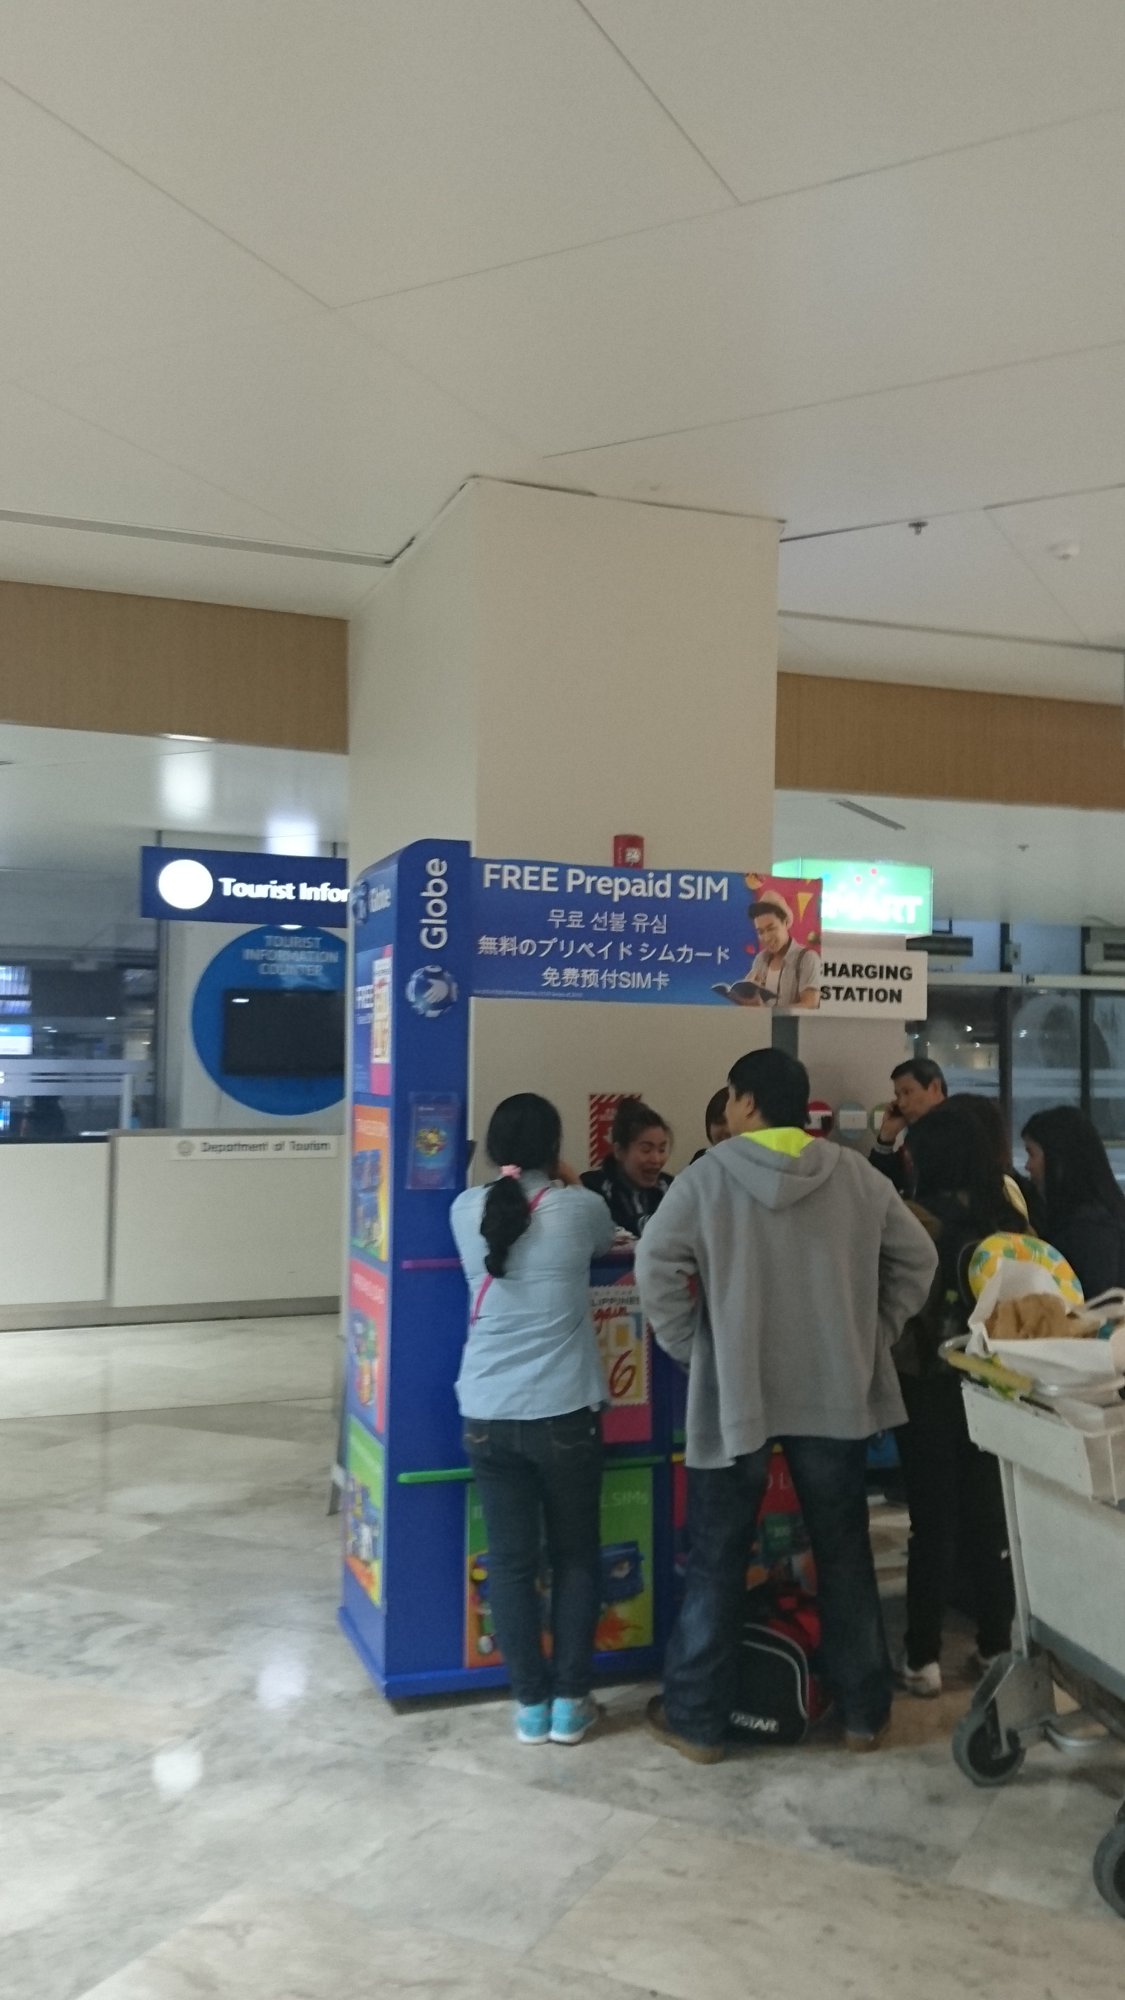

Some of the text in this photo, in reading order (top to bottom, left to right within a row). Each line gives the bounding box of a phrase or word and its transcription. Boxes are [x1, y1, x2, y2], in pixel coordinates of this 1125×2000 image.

[218, 877, 296, 900] Tourist
[483, 863, 729, 902] FREE Prepaid SIM
[419, 858, 448, 950] Globe
[547, 909, 667, 935] 무료 선불 유심
[264, 935, 322, 949] TOURIST
[243, 948, 339, 964] INFORMATION
[541, 966, 670, 991] 免费预付SIM卡
[820, 962, 913, 981] HARGING
[820, 985, 903, 1003] STATION
[288, 1140, 332, 1152] Tourism
